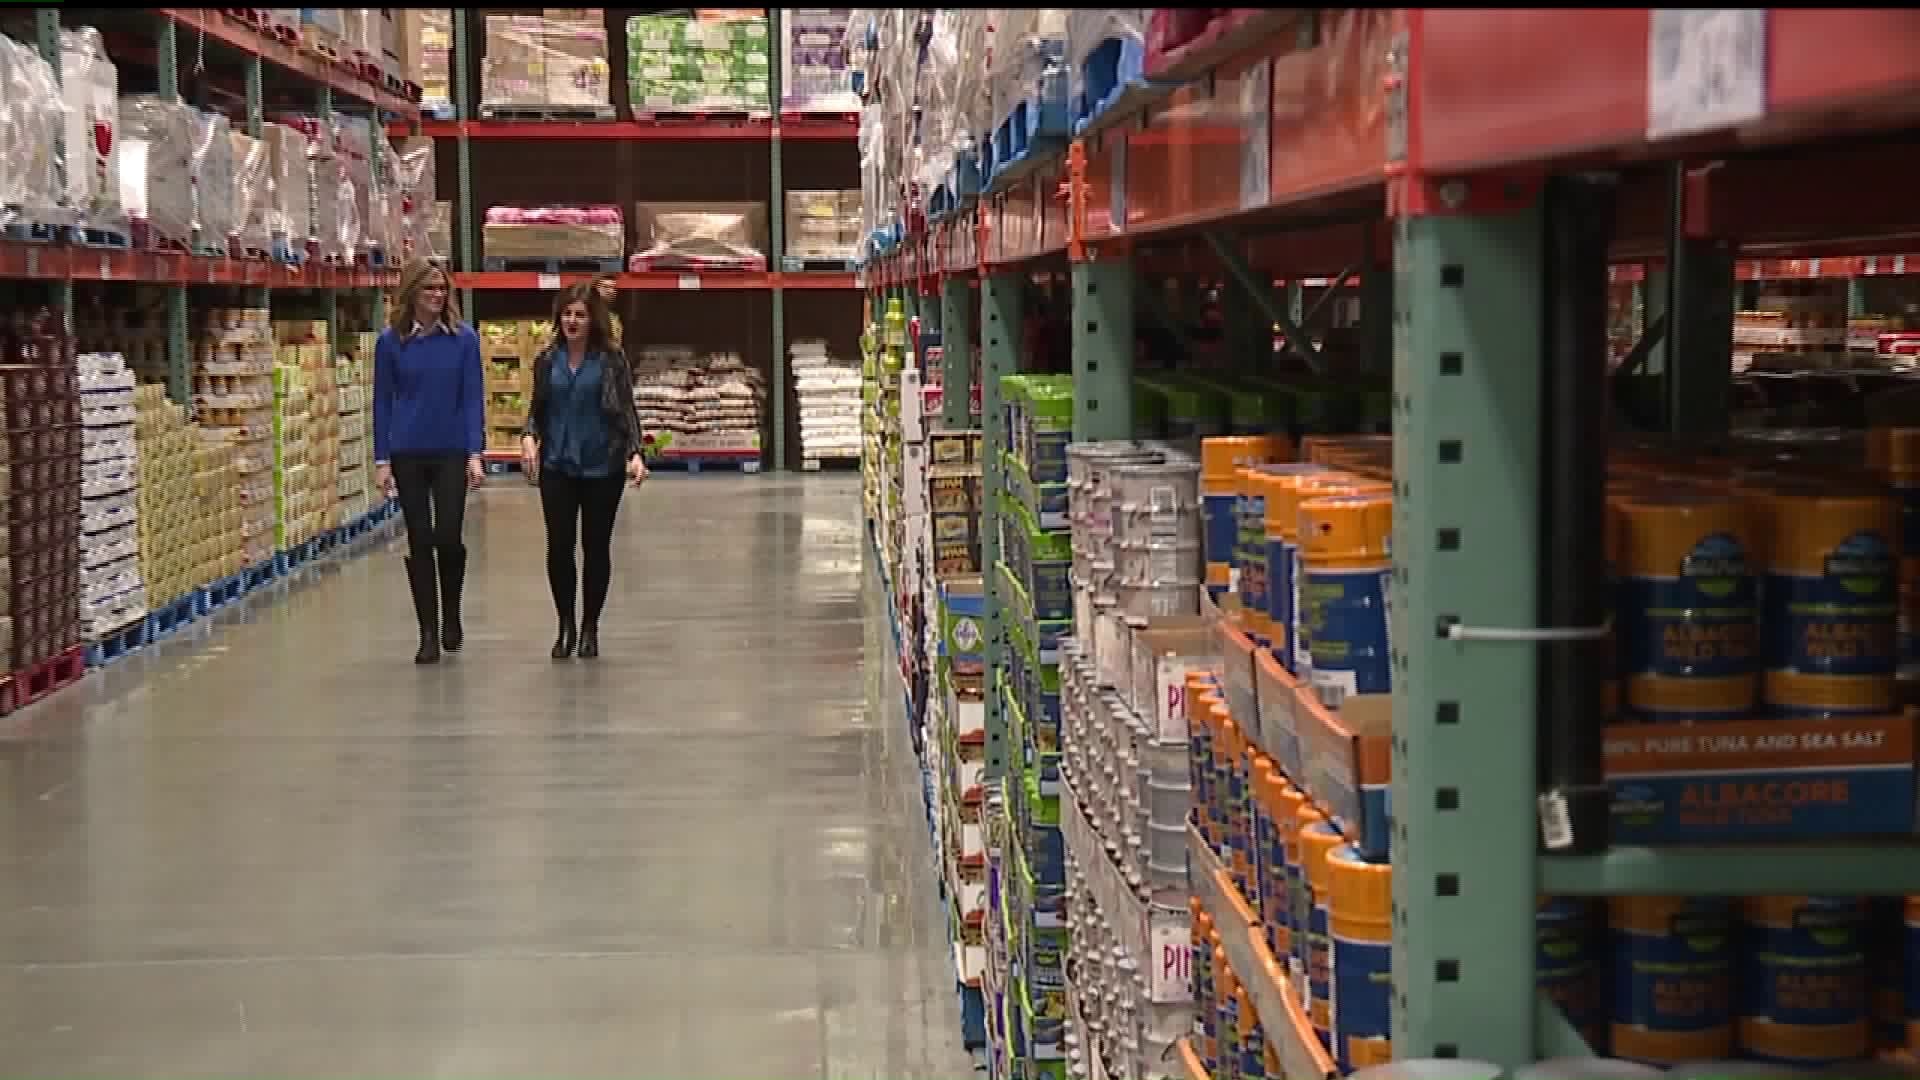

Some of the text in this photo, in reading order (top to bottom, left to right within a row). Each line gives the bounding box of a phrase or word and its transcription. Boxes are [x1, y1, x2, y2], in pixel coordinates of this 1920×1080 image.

[1167, 683, 1186, 719] PI
[1700, 735, 1747, 752] TUNA
[1754, 734, 1794, 750] AND
[1801, 731, 1835, 748] SEA
[1842, 729, 1886, 746] SALT
[1680, 779, 1850, 806] ALBACORE
